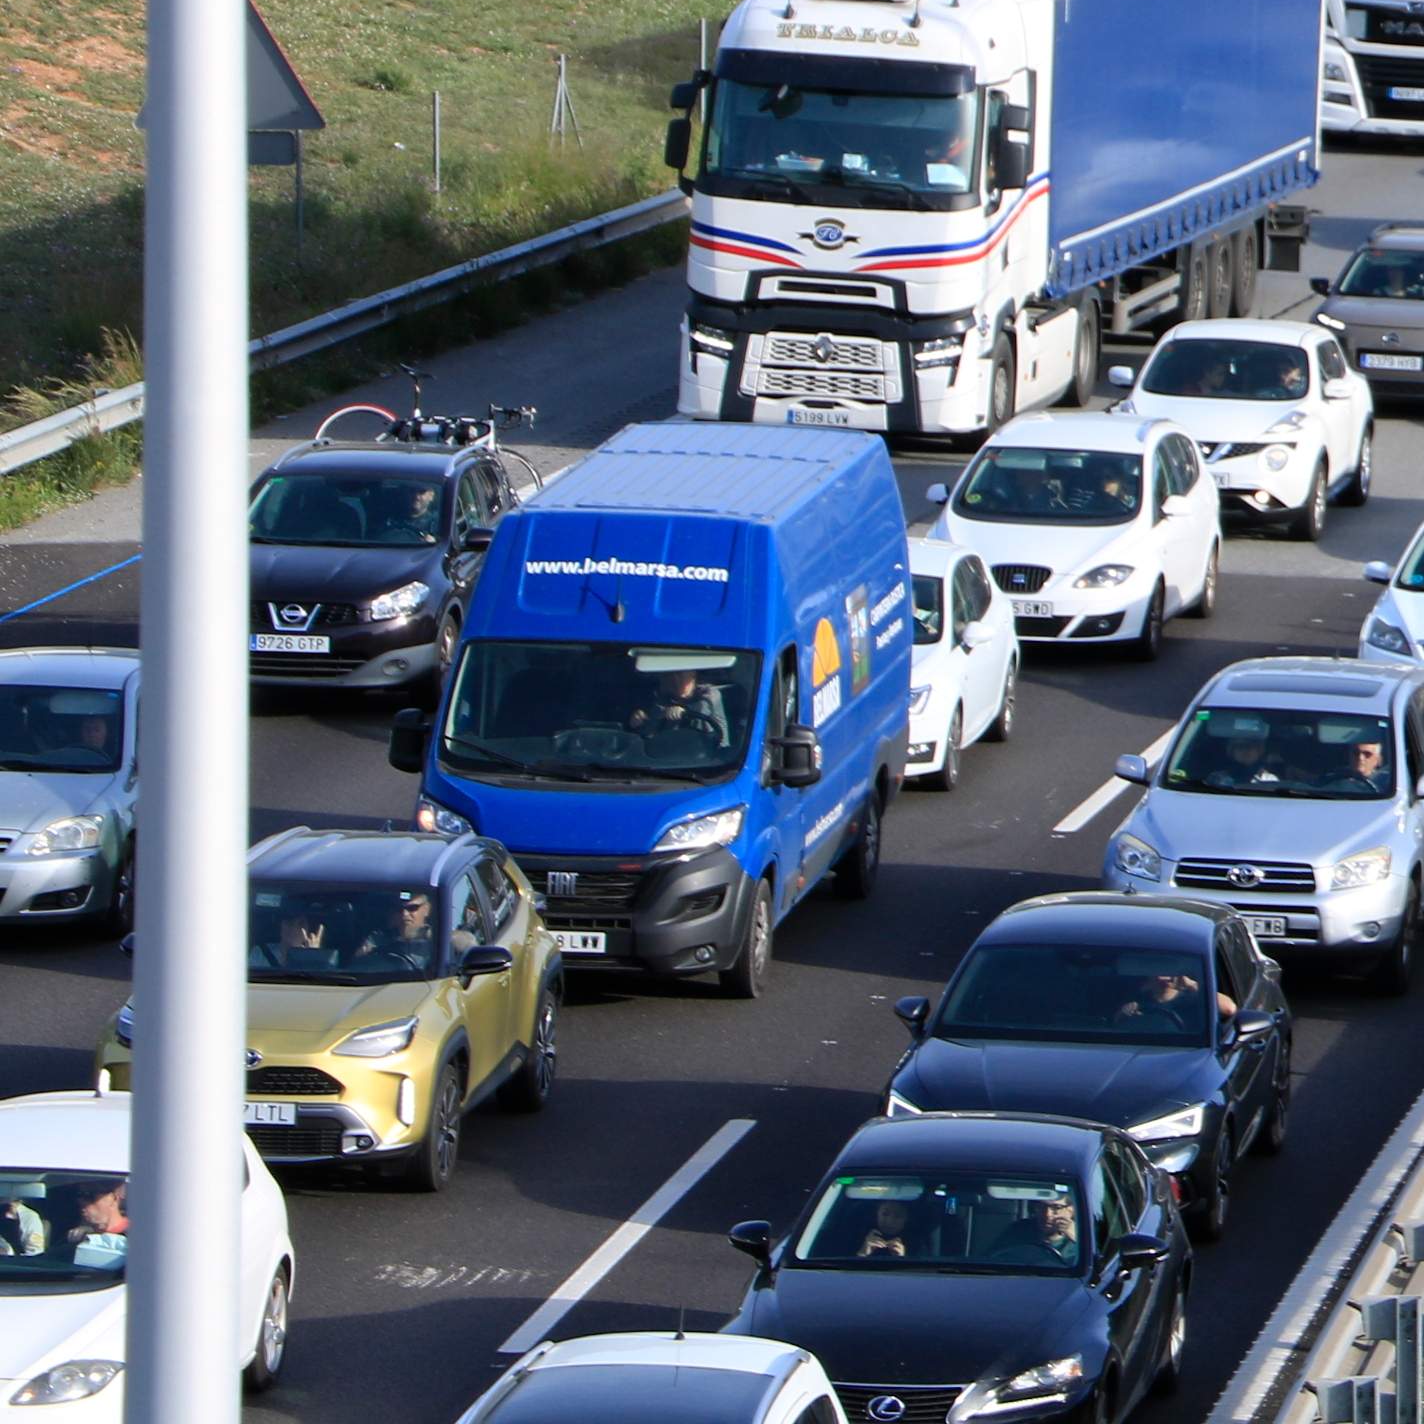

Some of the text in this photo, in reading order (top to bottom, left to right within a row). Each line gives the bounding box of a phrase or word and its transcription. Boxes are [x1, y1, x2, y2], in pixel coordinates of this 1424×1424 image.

[526, 558, 729, 582] www.belmarsa.com
[257, 636, 325, 650] 9726 GTP
[255, 1104, 288, 1122] LTL
